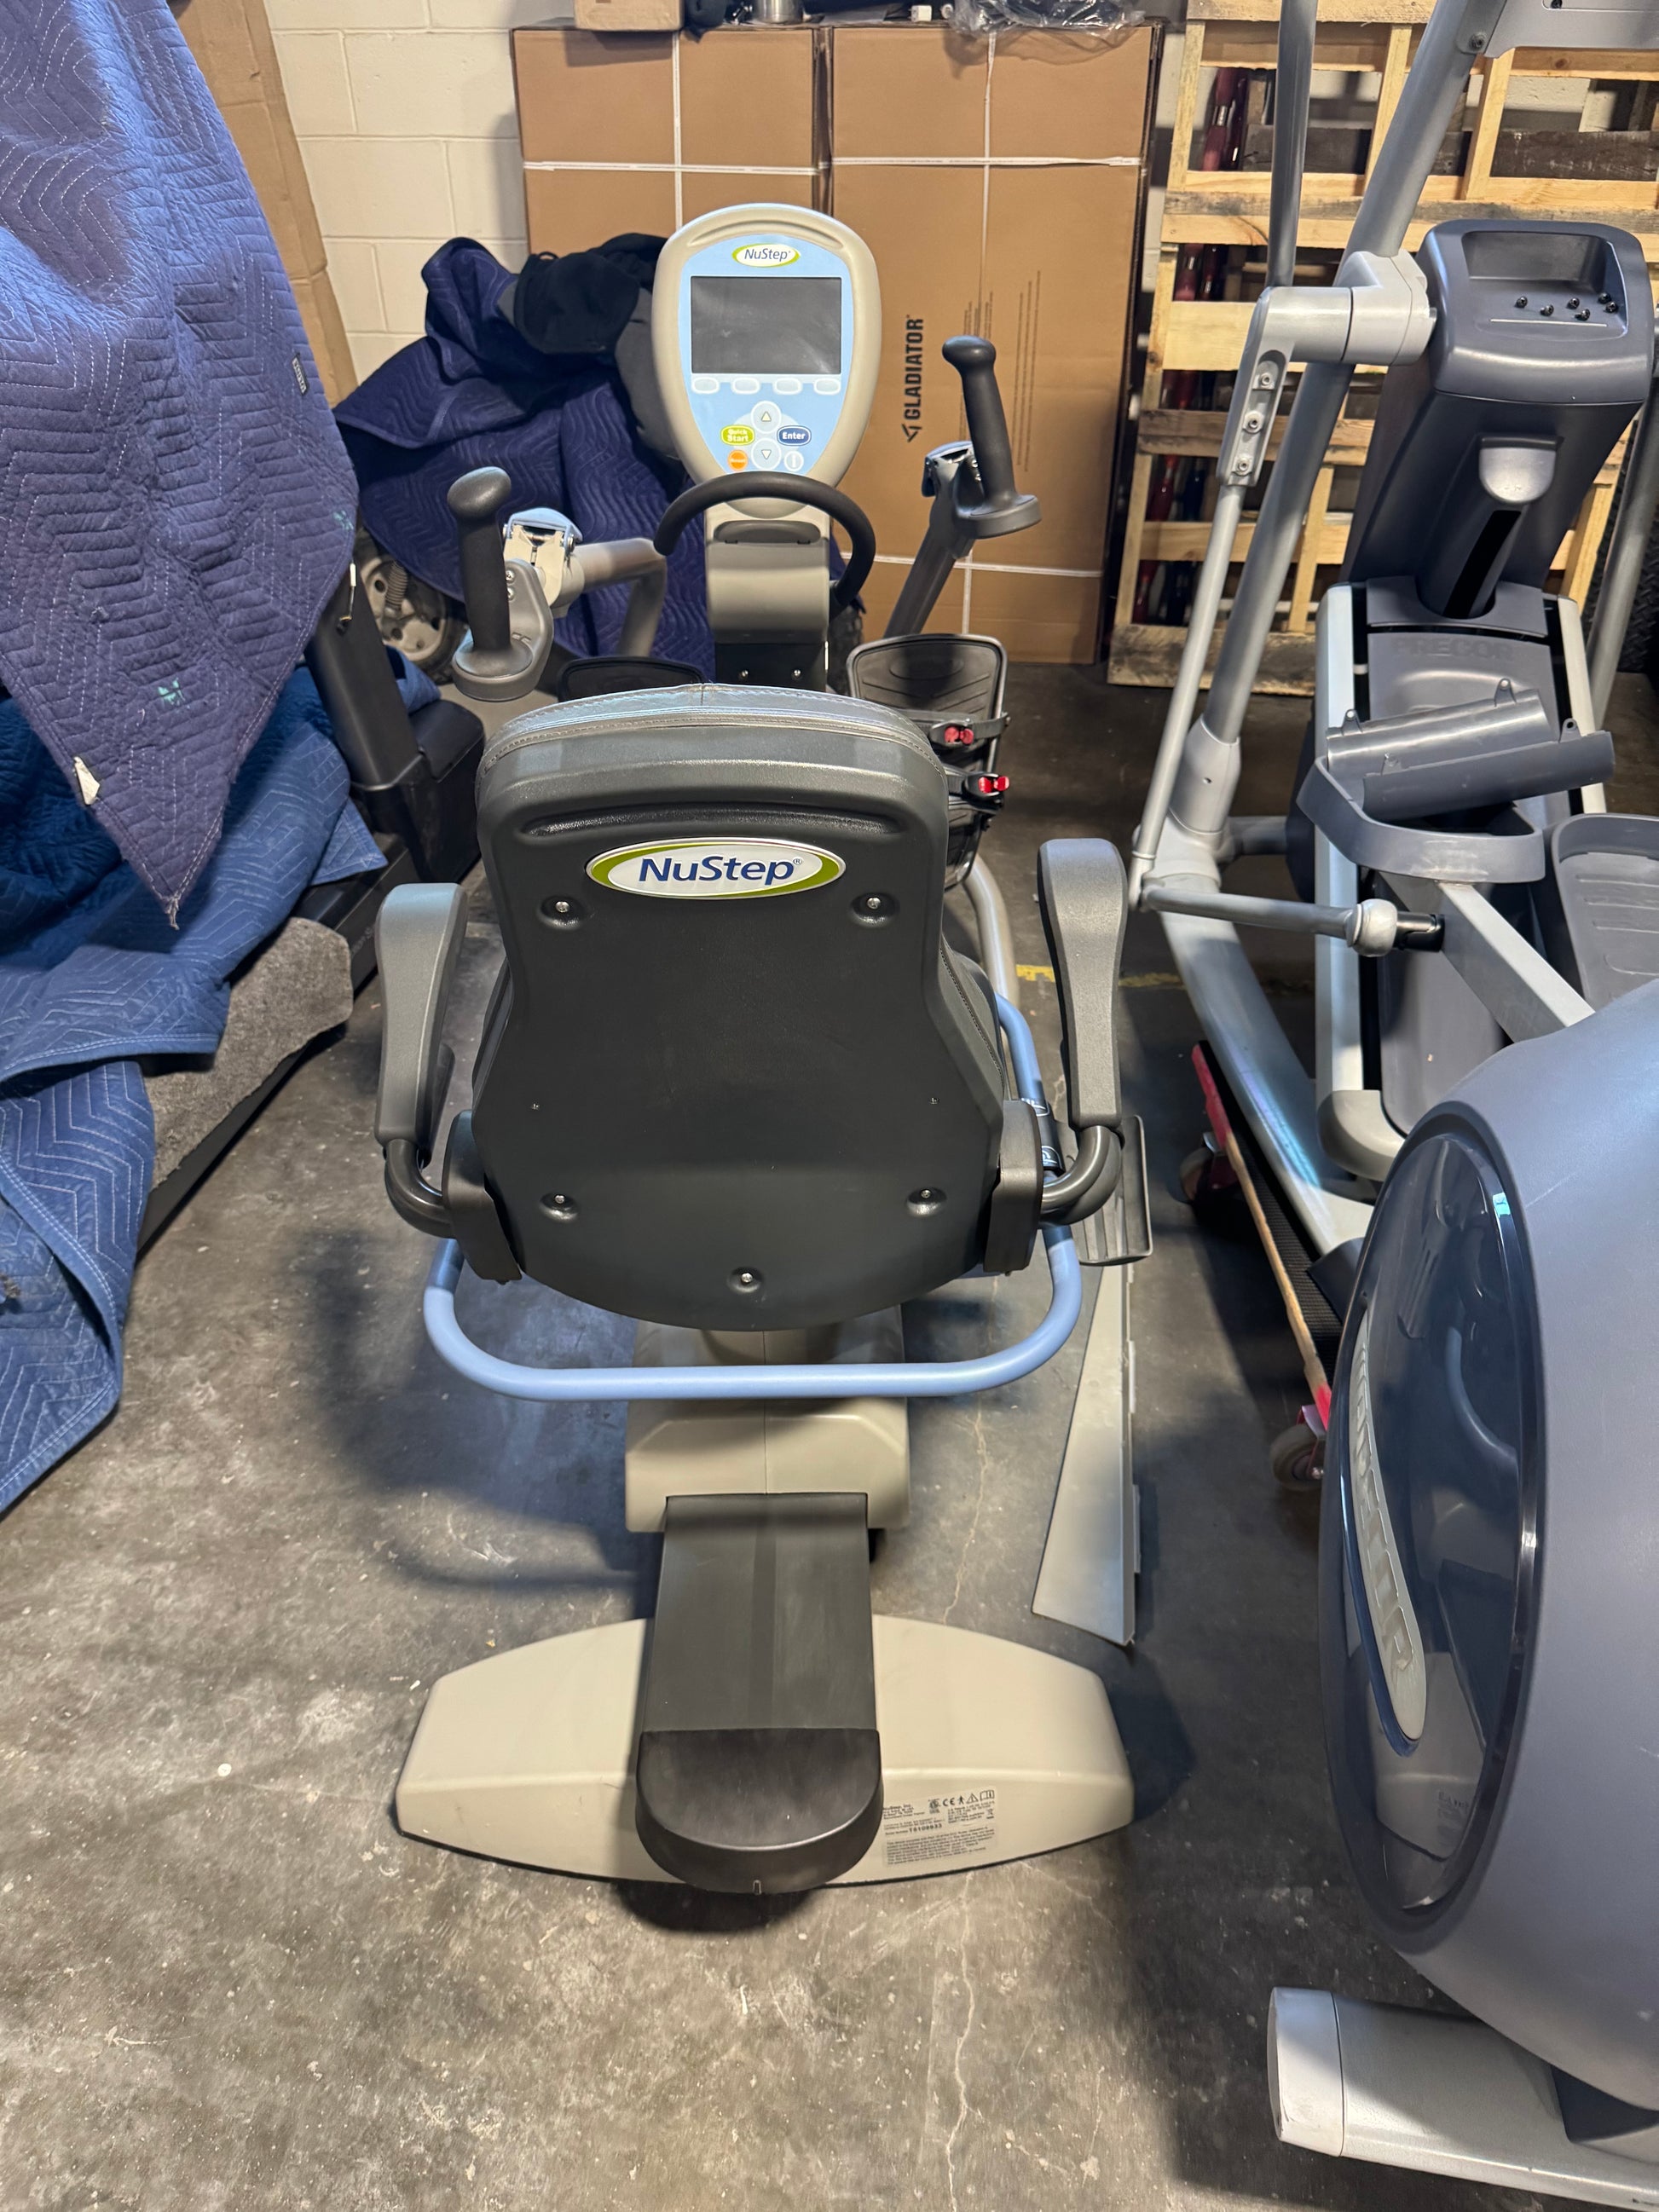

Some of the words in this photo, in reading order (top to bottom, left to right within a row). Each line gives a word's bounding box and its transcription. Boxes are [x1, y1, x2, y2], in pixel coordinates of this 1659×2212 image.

[744, 248, 789, 262] NuStep
[904, 318, 923, 420] GLADIATOR
[782, 431, 806, 440] Enter
[1390, 638, 1514, 661] PRECOR
